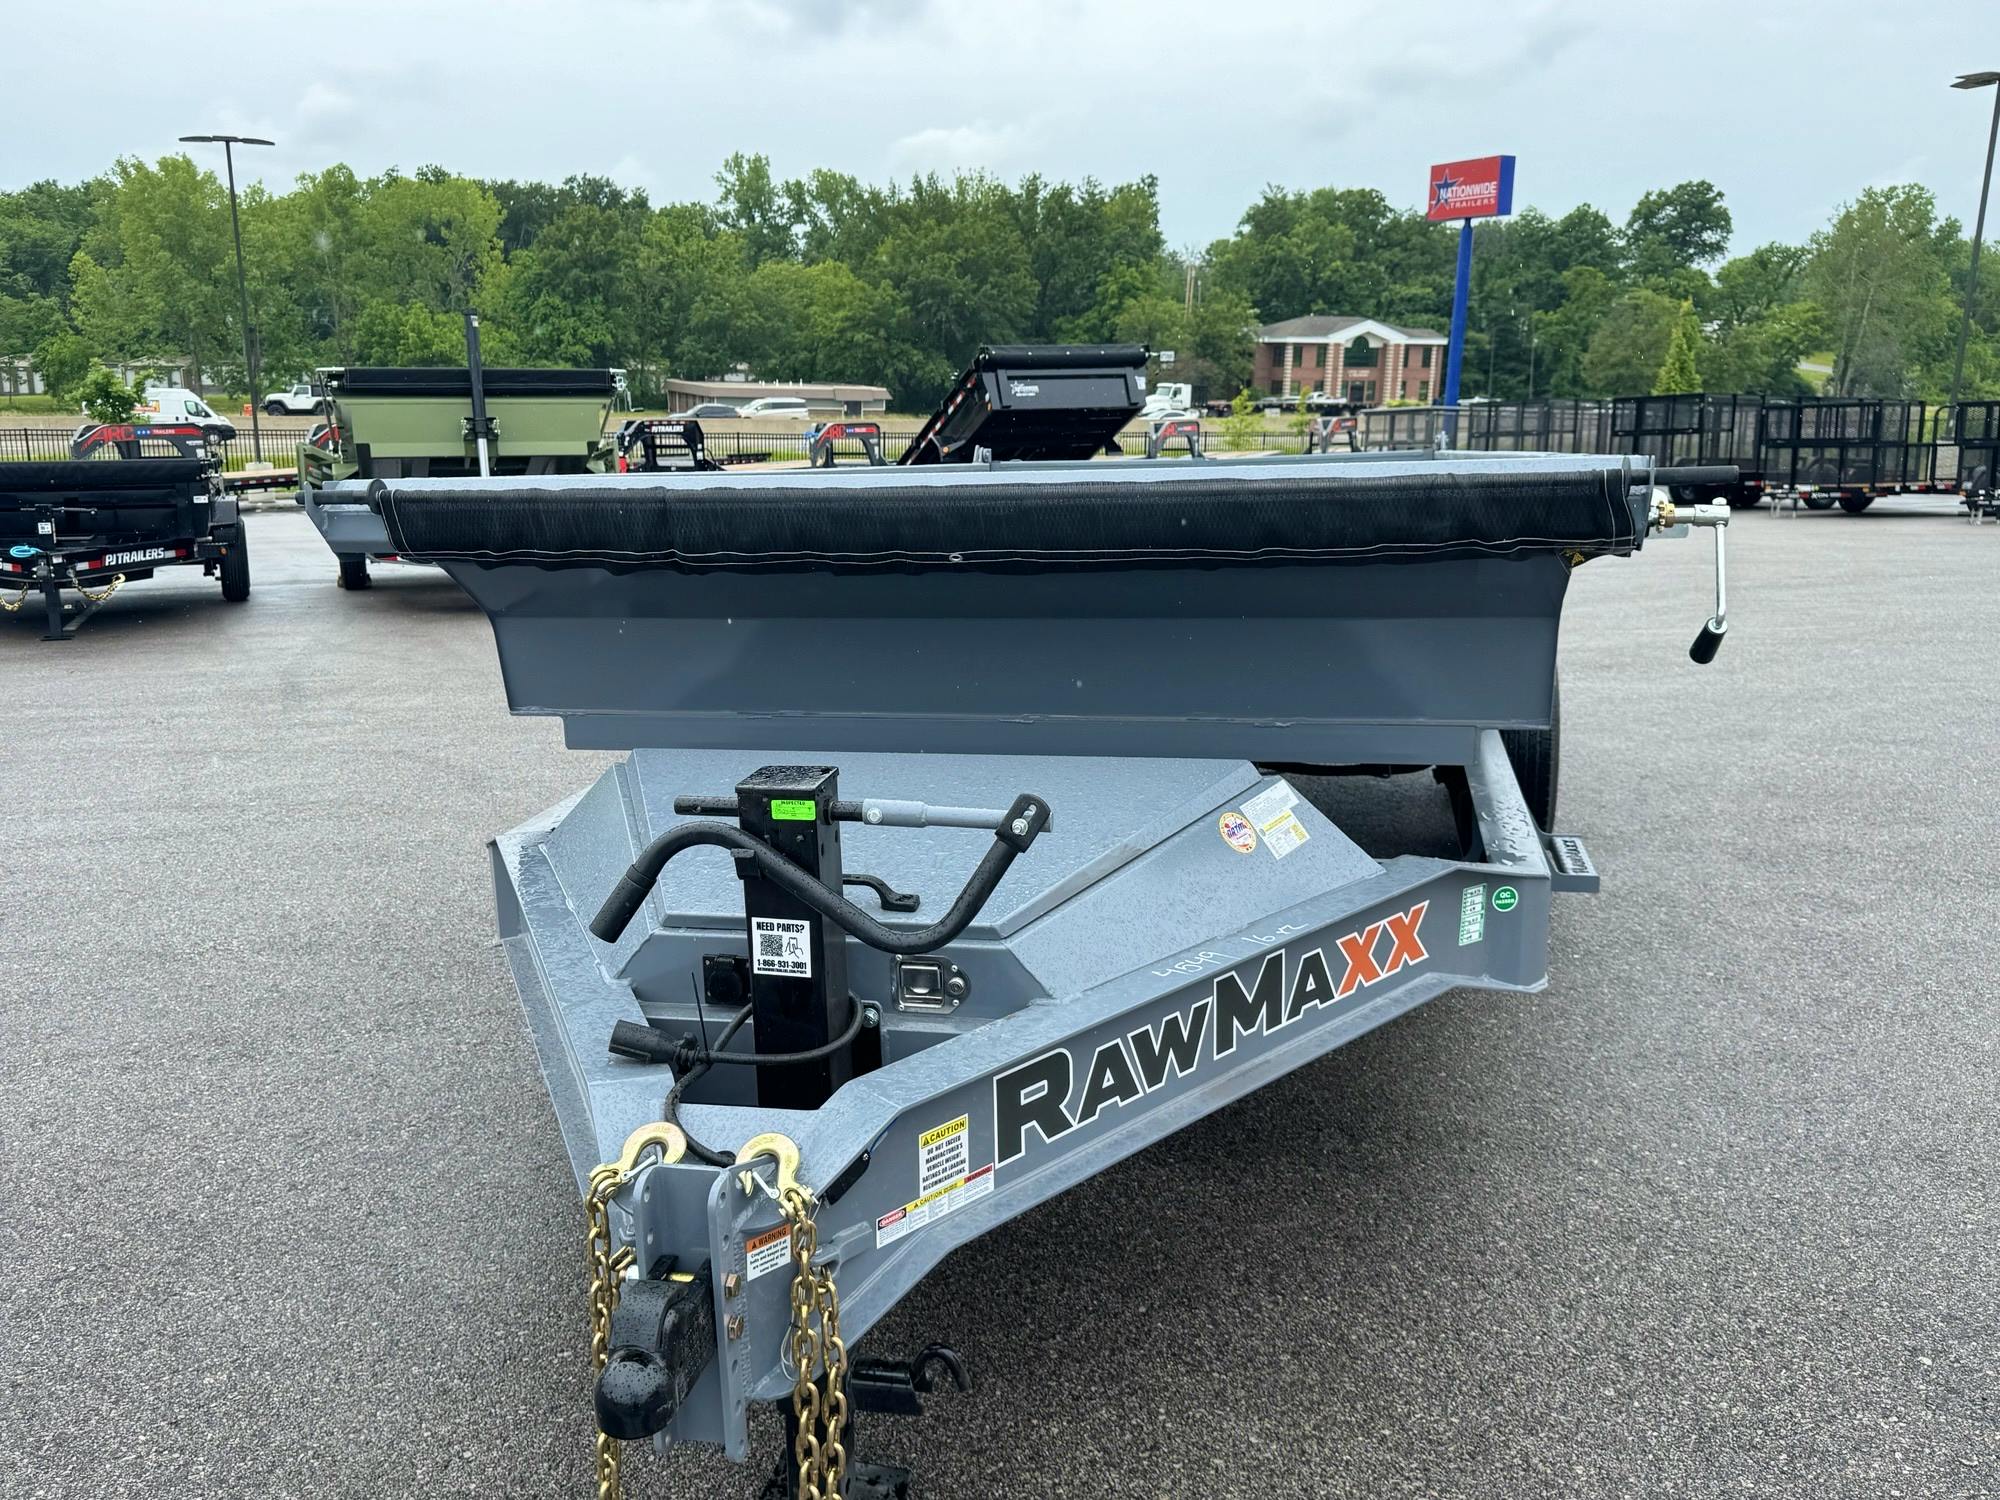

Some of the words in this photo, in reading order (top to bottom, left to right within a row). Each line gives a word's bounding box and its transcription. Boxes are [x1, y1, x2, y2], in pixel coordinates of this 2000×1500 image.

[1440, 181, 1497, 200] NATIONWIDE
[1450, 198, 1495, 209] TRAILERS
[1500, 891, 1511, 899] QC
[756, 921, 775, 932] NEED
[776, 922, 805, 934] PARTS?
[757, 959, 807, 970] 1-866-931-3001
[930, 1120, 965, 1142] CAUTION
[927, 1147, 934, 1156] DO
[935, 1142, 944, 1152] NOT
[945, 1135, 961, 1147] EXCEED
[922, 1169, 942, 1184] RATINGS
[941, 1166, 948, 1175] OR
[948, 1158, 966, 1171] LOADING
[927, 1158, 944, 1173] VEHICLE
[945, 1151, 962, 1164] WEIGHT
[920, 1190, 943, 1205] CAUTION
[758, 1227, 787, 1246] WARNING
